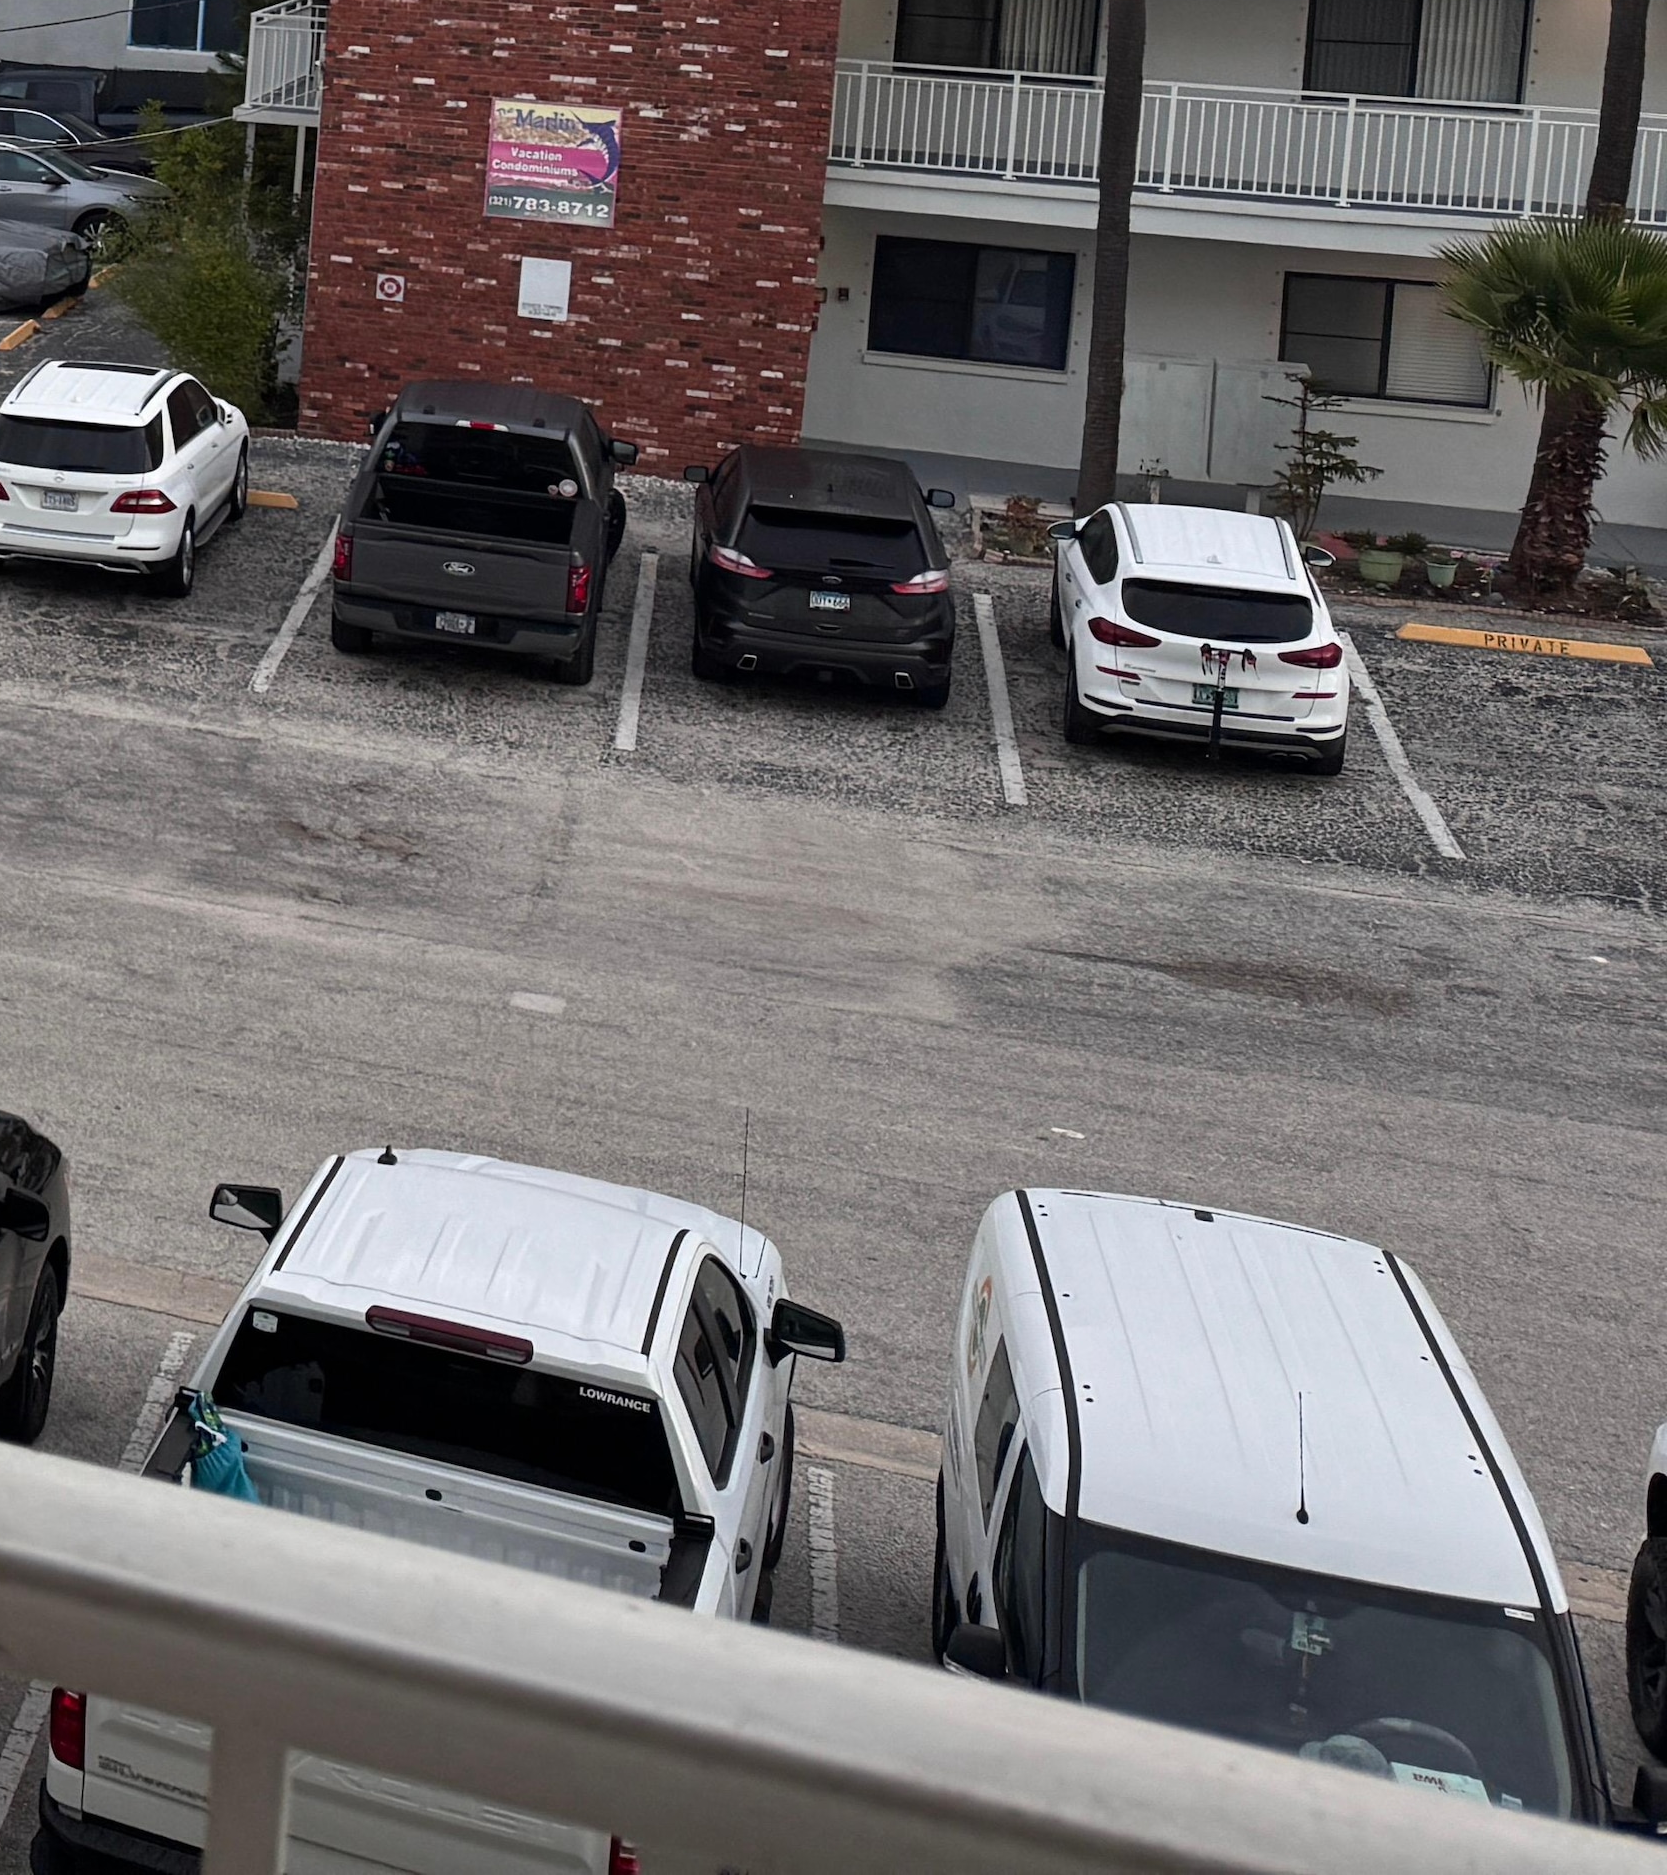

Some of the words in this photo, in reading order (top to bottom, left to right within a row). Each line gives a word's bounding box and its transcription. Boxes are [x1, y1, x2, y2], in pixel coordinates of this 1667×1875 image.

[516, 108, 576, 131] Marlin
[511, 146, 562, 162] Vacation
[492, 159, 579, 177] Condominiums
[489, 195, 512, 207] (321)
[1484, 633, 1570, 655] PRIVATE
[579, 1386, 651, 1413] LOWRANCE
